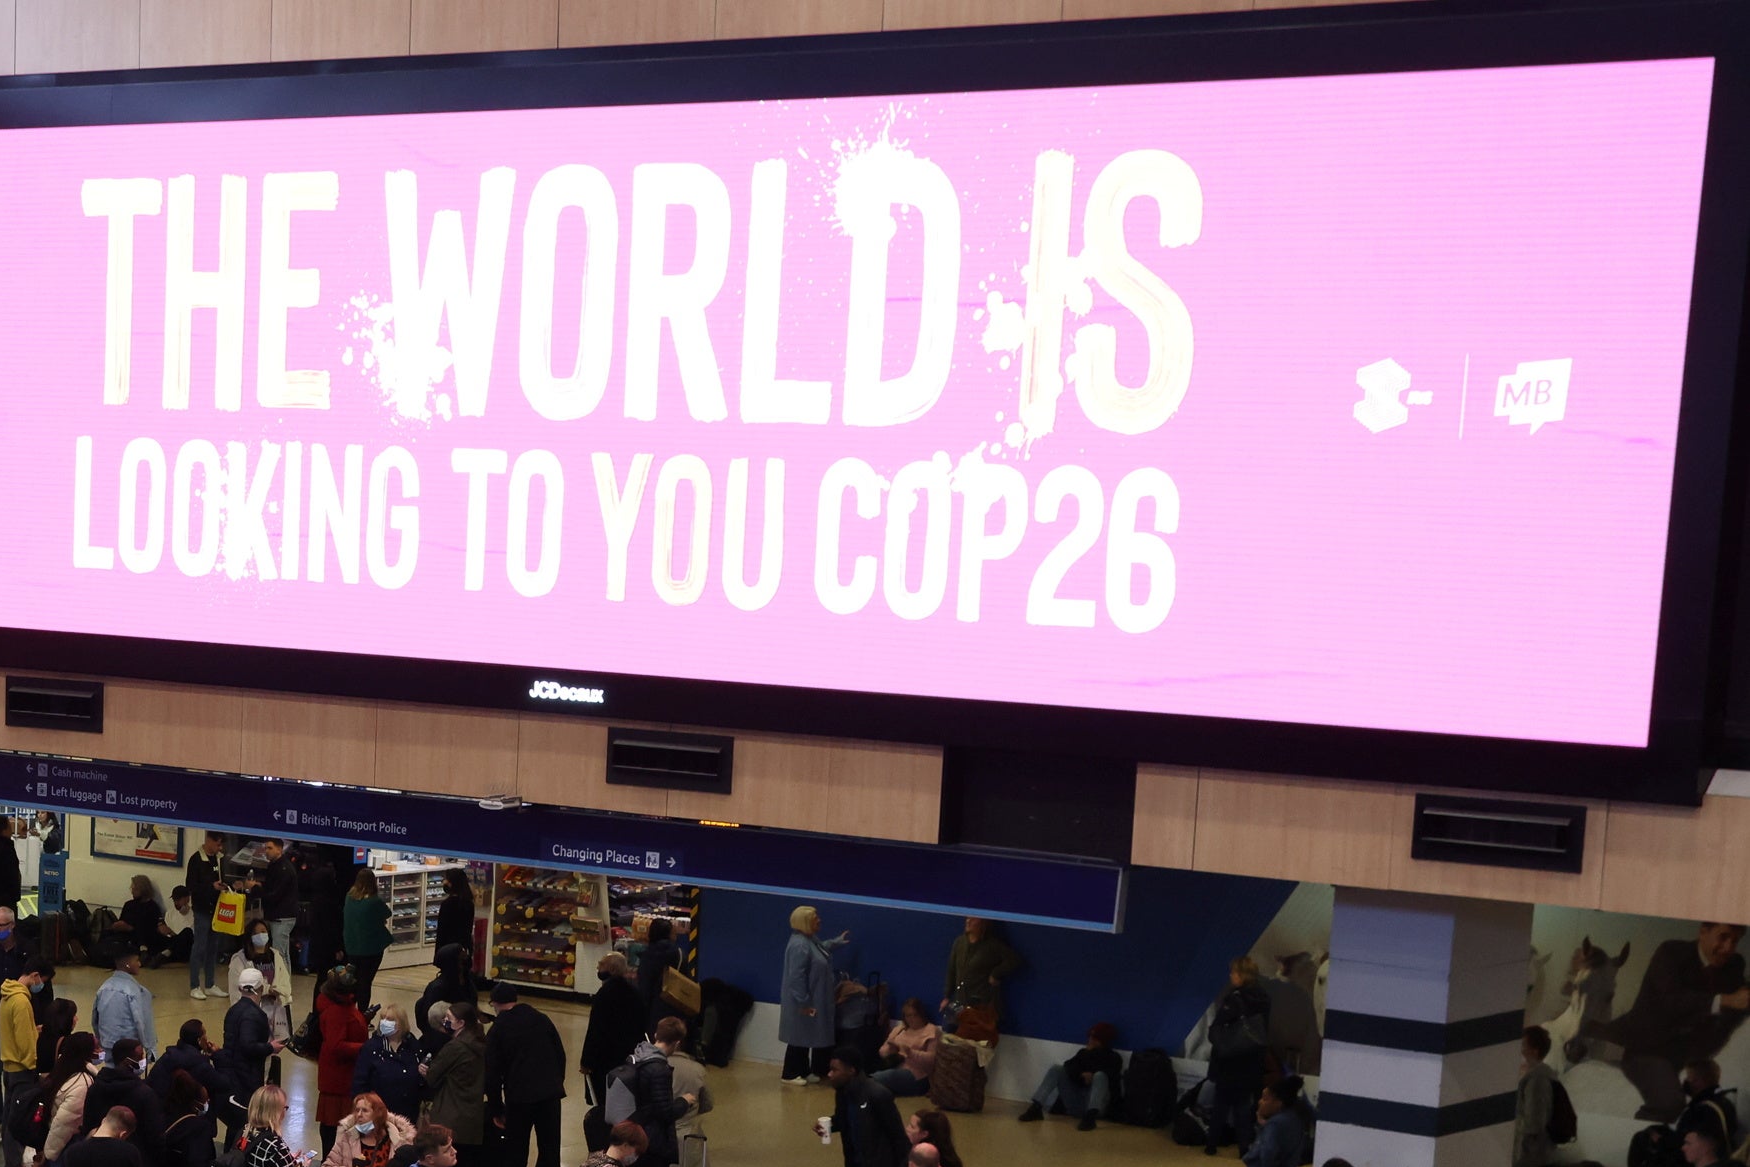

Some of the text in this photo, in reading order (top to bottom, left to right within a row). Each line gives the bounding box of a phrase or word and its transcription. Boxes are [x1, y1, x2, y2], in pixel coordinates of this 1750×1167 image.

[81, 148, 1203, 435] THE WORLD IS
[1501, 377, 1553, 409] MB
[72, 436, 1181, 633] LOOKING TO YOU COP26
[51, 766, 108, 783] Cash machine
[51, 785, 103, 804] Left luggage
[119, 792, 179, 813] Lost property
[301, 811, 408, 836] British Transport Police
[551, 844, 641, 867] Changing Places
[218, 908, 236, 918] LEGO
